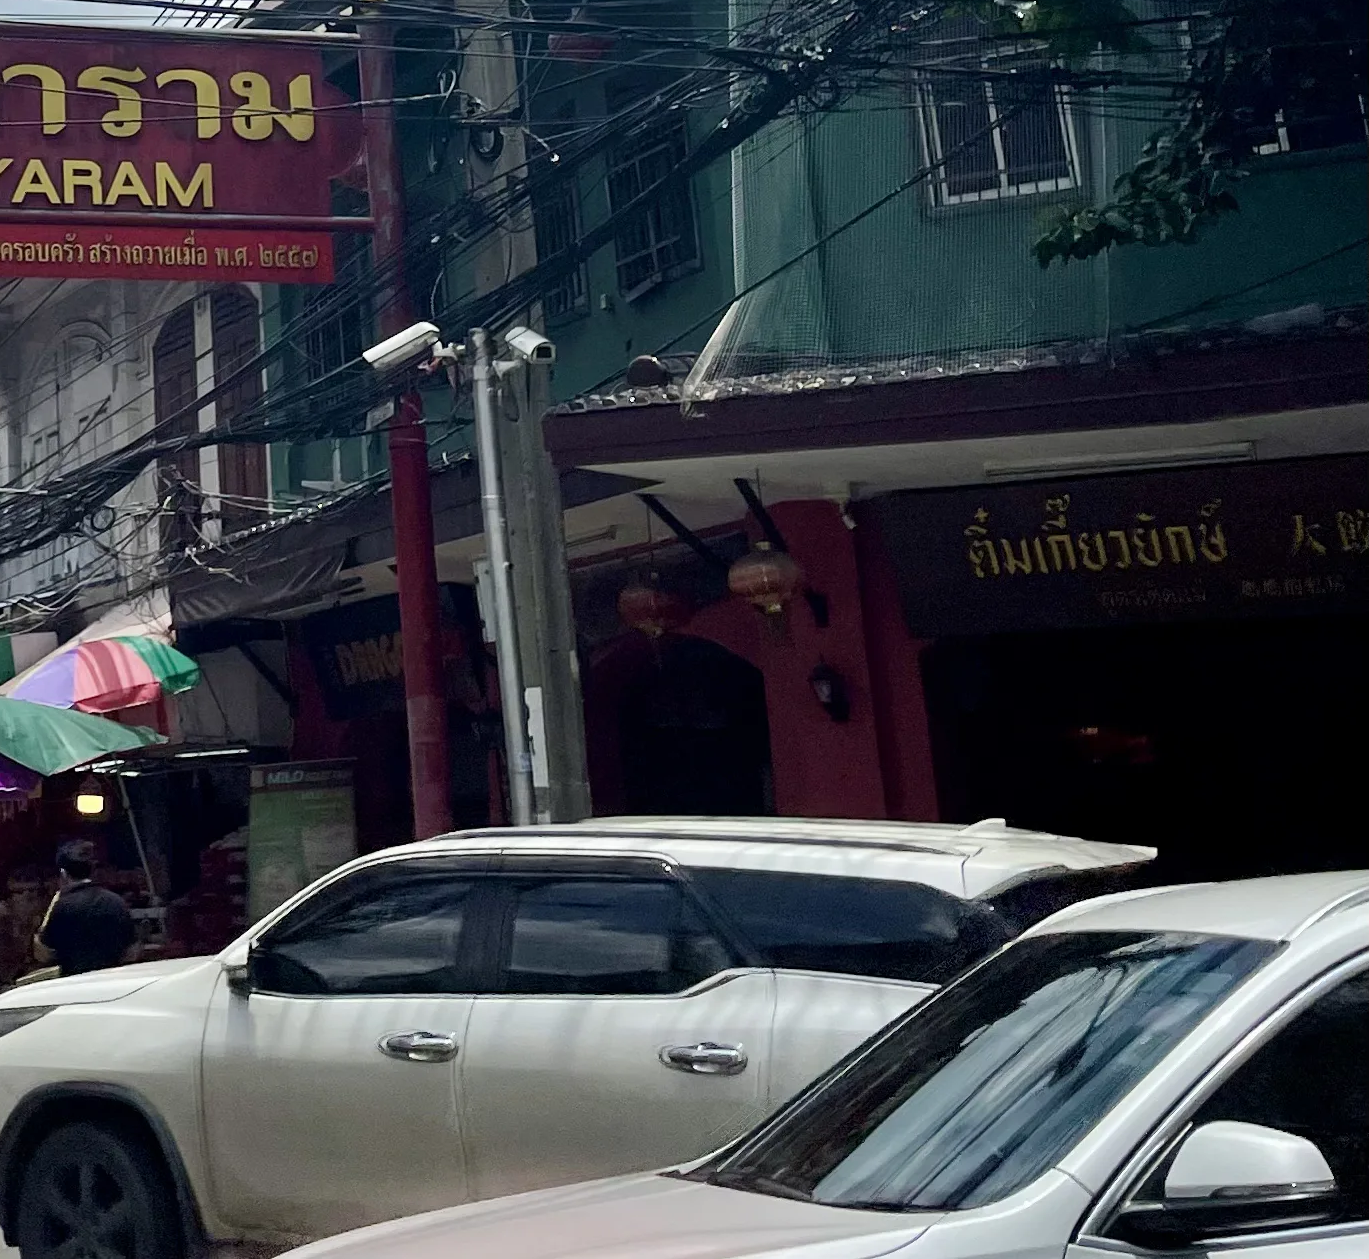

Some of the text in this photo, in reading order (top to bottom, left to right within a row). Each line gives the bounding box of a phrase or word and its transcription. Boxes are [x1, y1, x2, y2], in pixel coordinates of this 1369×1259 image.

[88, 230, 208, 267] สร้างถวายเมื่อ
[214, 245, 253, 267] พ.ศ.
